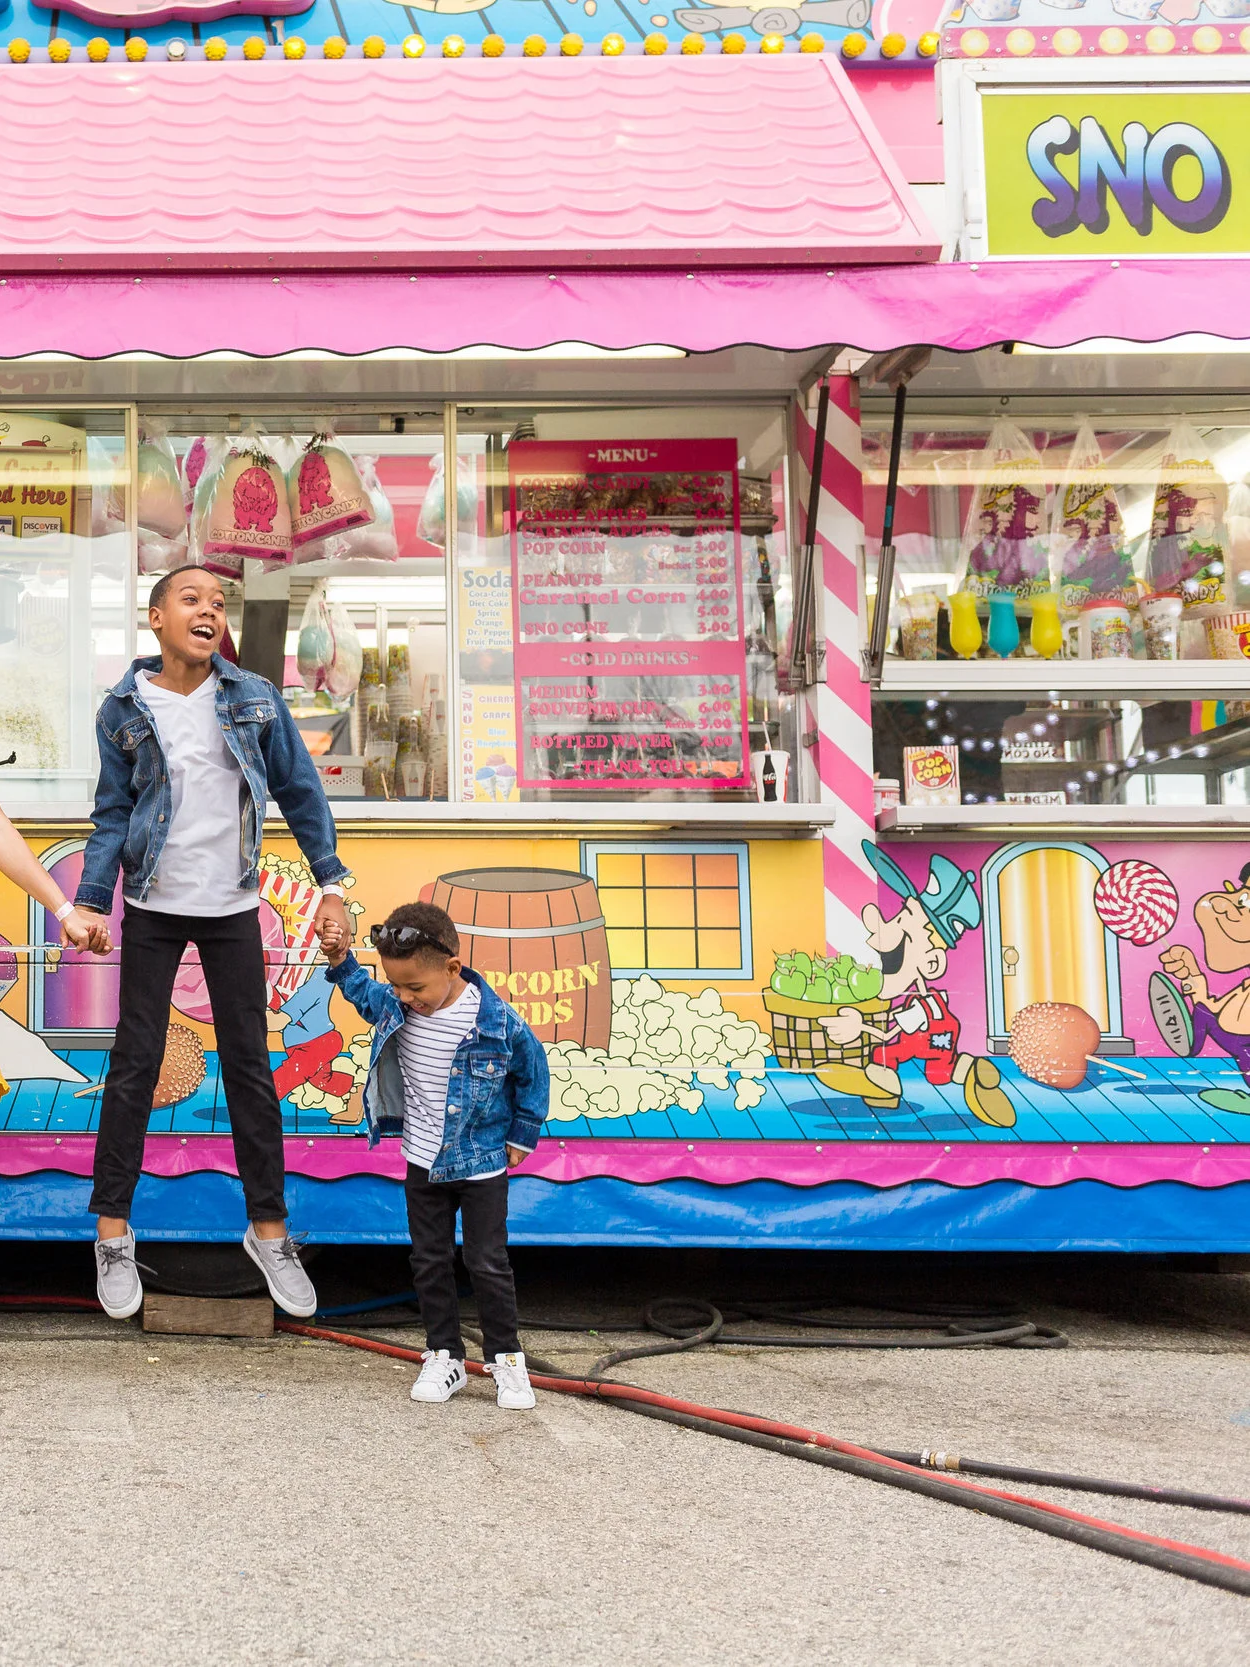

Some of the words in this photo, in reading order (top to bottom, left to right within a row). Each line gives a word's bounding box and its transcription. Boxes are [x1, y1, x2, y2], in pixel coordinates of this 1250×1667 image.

[1026, 115, 1232, 238] SNO
[521, 477, 588, 491] COTTON
[593, 476, 650, 490] CANDY
[21, 484, 67, 505] Here
[522, 509, 580, 523] CANDY
[582, 508, 647, 522] APPLES
[23, 522, 59, 530] DISCOVER
[522, 525, 603, 539] CARAMEL
[608, 524, 671, 538] APPLES
[522, 541, 555, 555] POP
[558, 541, 607, 555] CORN
[463, 570, 513, 588] Soda
[523, 573, 603, 588] PEANUTS
[469, 590, 508, 598] Coca-Cola
[520, 588, 619, 605] Caramel
[627, 588, 687, 604] Corn
[477, 609, 500, 618] Sprite
[474, 619, 503, 627] Orange
[524, 622, 559, 635] SNO
[562, 621, 609, 635] CONE
[488, 638, 512, 646] Punch
[529, 685, 598, 699] MEDIUM
[529, 702, 619, 716] SOUVENIR
[621, 701, 656, 715] CUP
[530, 735, 609, 749] BOTTLED
[611, 734, 672, 748] WATER
[916, 756, 944, 769] POP
[915, 763, 952, 782] CORN
[272, 903, 288, 914] OT
[476, 960, 600, 996] PCORN
[509, 998, 574, 1026] EDS
